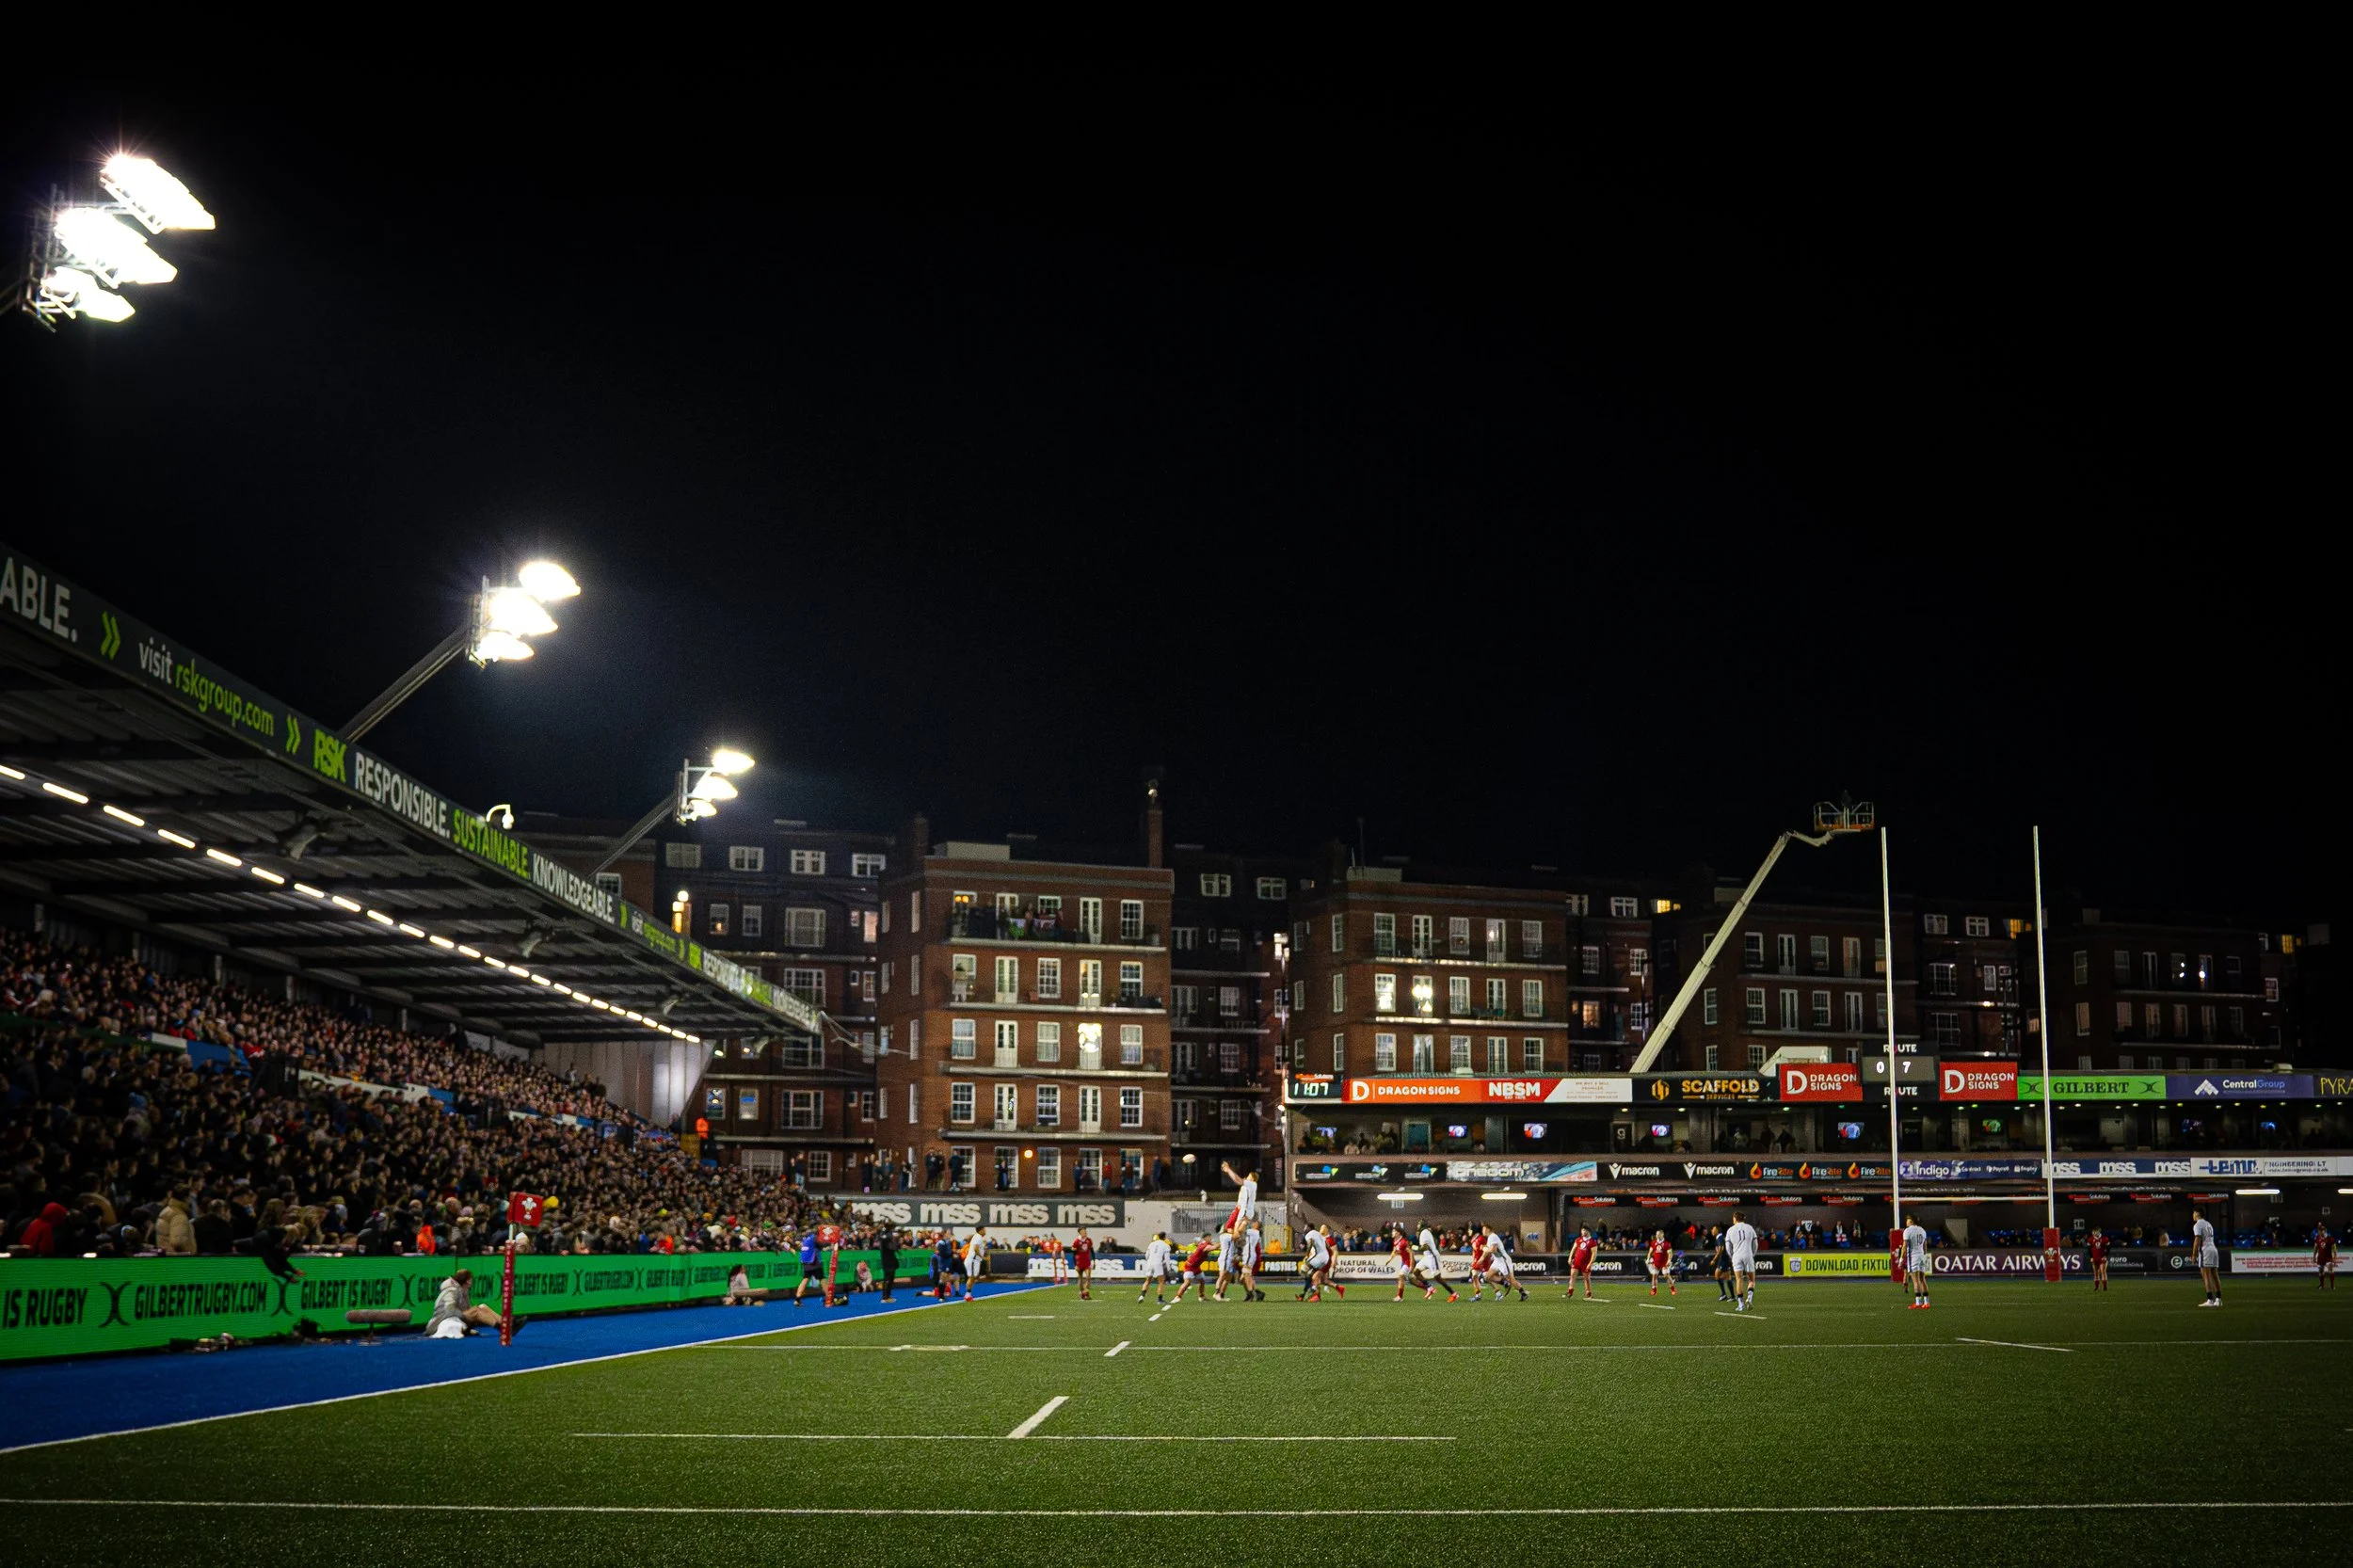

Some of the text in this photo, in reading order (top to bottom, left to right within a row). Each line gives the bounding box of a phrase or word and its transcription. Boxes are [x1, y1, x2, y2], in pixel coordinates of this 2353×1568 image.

[0, 556, 77, 642] ABLE.
[139, 637, 274, 737] visit rskgroup.com
[313, 728, 347, 783] RSK
[355, 752, 451, 839] RESPONSIBLE.
[533, 853, 615, 925] KNOWLEDGEABLE.
[1883, 1044, 1917, 1052] RUTE
[1877, 1062, 1911, 1073] 0 7
[1968, 1073, 2014, 1081] DRAGON
[1378, 1086, 1426, 1096] DRAGON
[1428, 1086, 1460, 1095] SIGNS
[1489, 1082, 1540, 1096] NBSM
[1681, 1080, 1760, 1093] SCAFFOLD
[1810, 1082, 1842, 1091] SIGNS
[1884, 1086, 1918, 1096] RUTE
[1968, 1081, 1999, 1090] SIGNS
[2053, 1082, 2129, 1094] GILBERT
[1617, 1128, 1626, 1140] 9
[1622, 1166, 1659, 1176] macron
[1696, 1165, 1734, 1176] macron
[1914, 1164, 1949, 1177] Indigo
[2099, 1161, 2137, 1175] mss
[2155, 1161, 2191, 1175] mss
[920, 1203, 981, 1224] mss
[989, 1204, 1049, 1224] mss
[1057, 1204, 1116, 1224] mss
[1265, 1261, 1298, 1272] PASTIES
[1592, 1261, 1622, 1271] acron
[1805, 1258, 1891, 1272] DOWNLOAD FIXTU
[1934, 1255, 2081, 1272] QATAR AIRWYS
[301, 1277, 393, 1310] GILBERT IS RUGBY
[135, 1281, 267, 1320] GILBERTRUGBY.COM
[3, 1287, 88, 1328] IS RUGBY
